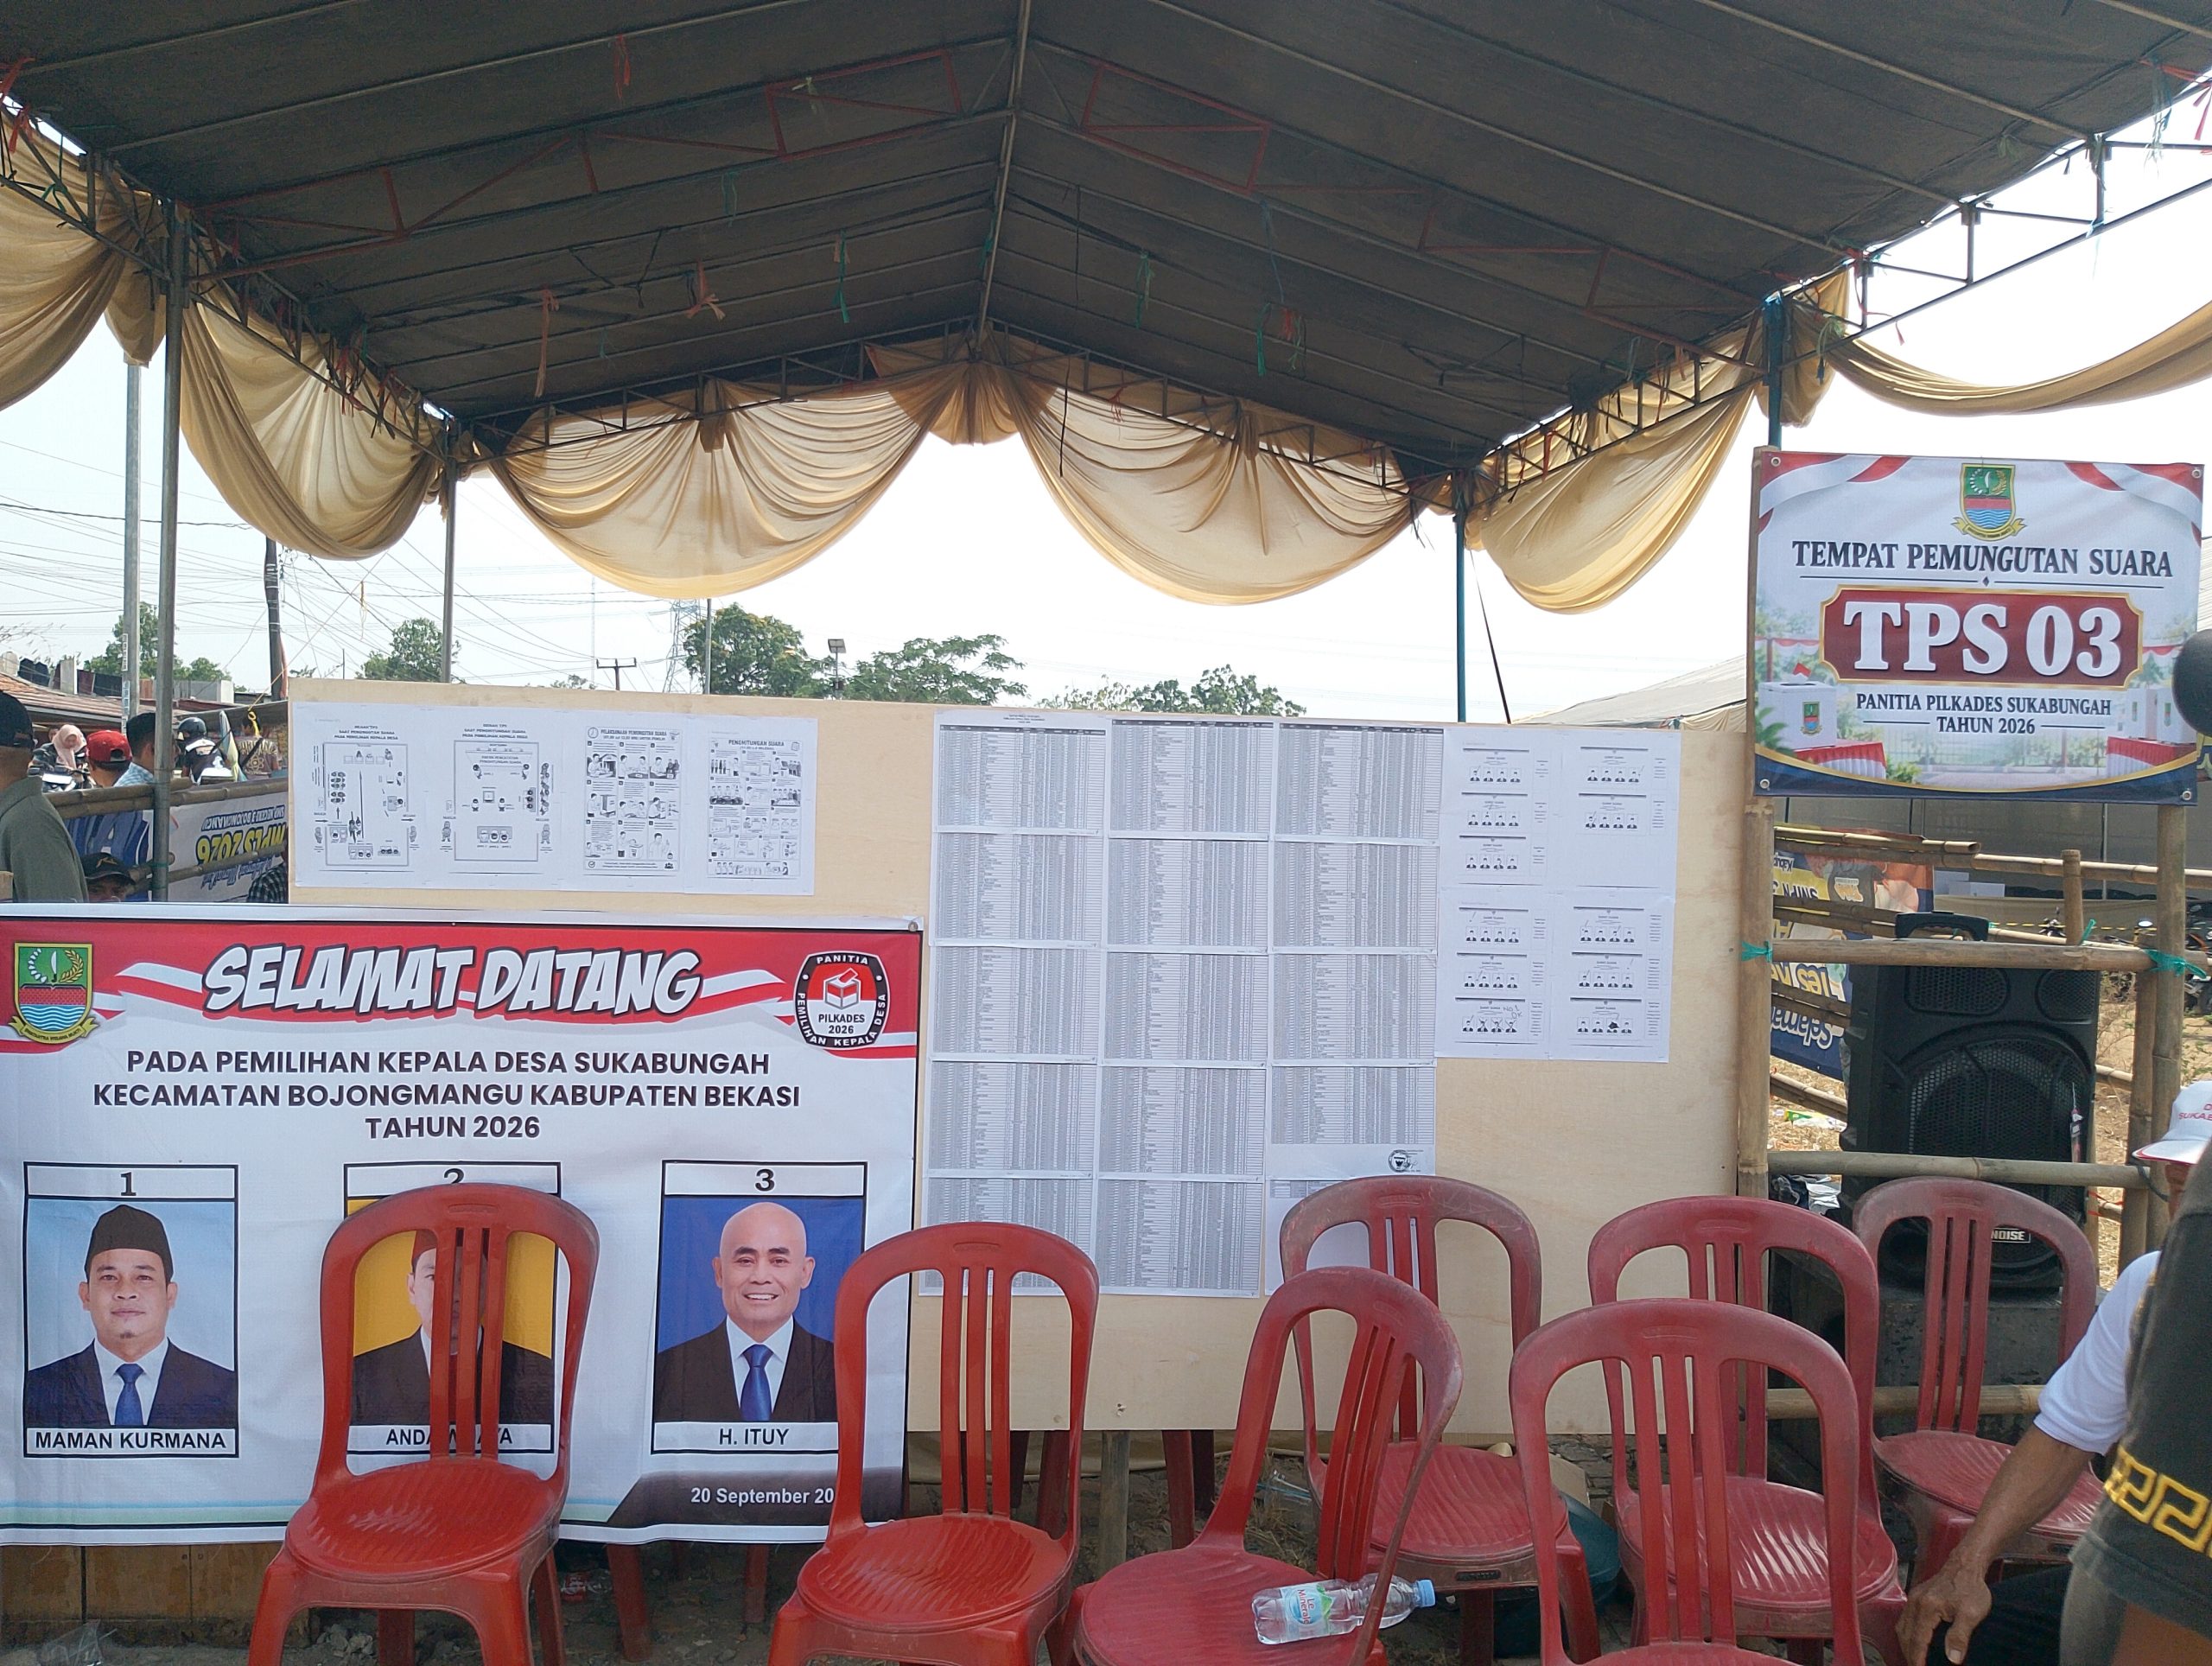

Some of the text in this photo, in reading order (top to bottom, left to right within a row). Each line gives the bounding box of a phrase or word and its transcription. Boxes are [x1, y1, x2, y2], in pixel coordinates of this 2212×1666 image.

[1791, 540, 2172, 577] TEMPAT PEMUNGUTAN SUARA
[1843, 601, 2122, 677] TPS 03
[1856, 693, 2111, 715] PANITIA PILKADES SUKABUNGAH
[1936, 717, 2035, 734] TAHUN 2026
[816, 954, 868, 965] PANITIA
[203, 943, 702, 1016] SELAMAT DATANG
[797, 992, 887, 1046] PEMILIHAN KEPALA DESA
[817, 1014, 865, 1023] PILKADES
[828, 1025, 855, 1034] 2026
[1770, 1007, 1833, 1050] Selama
[126, 1050, 770, 1075] PADA PEMILIHAN KEPALA DESA SUKABUNGAH
[92, 1083, 800, 1108] KECAMATAN BOJONGMANGU KABUPATEN BEKASI
[365, 1116, 541, 1140] TAHUN 2026
[119, 1171, 137, 1197] 1
[754, 1167, 776, 1192] 3
[35, 1432, 227, 1451] MAMAN KURMANA
[719, 1428, 790, 1446] H. ITUY
[690, 1487, 835, 1507] 20 September 20
[1297, 1589, 1312, 1625] Minerale
[1306, 1598, 1315, 1609] Le
